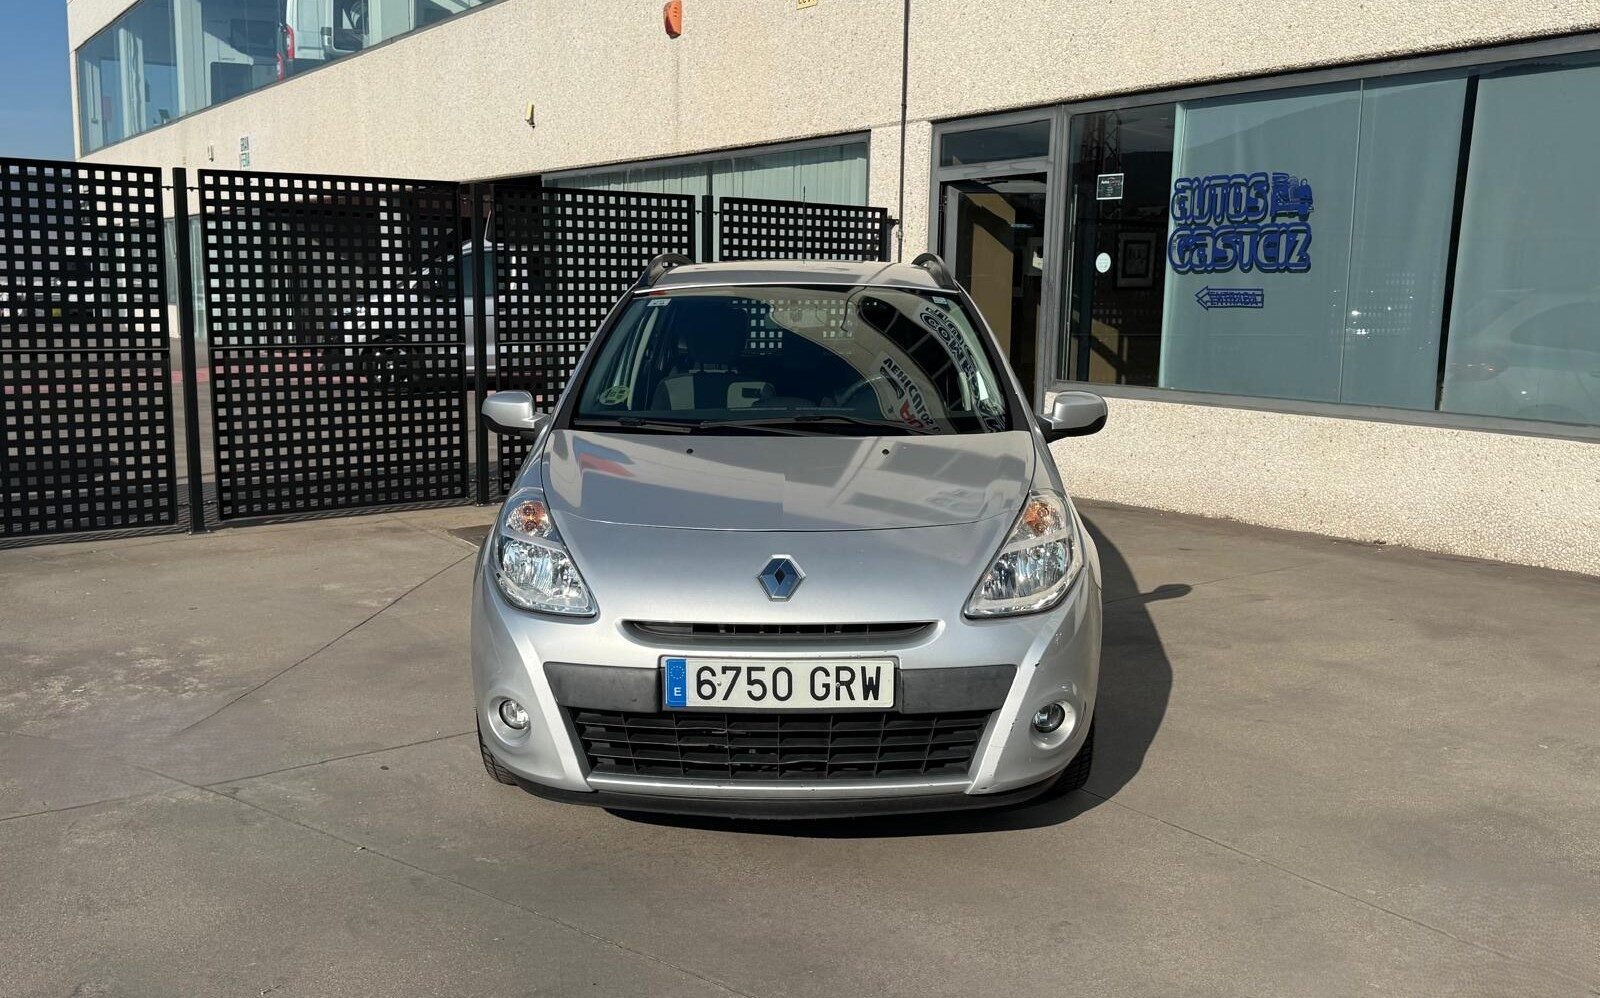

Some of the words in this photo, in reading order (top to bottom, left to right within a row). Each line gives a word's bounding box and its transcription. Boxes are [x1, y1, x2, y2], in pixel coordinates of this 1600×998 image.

[673, 686, 682, 697] E
[696, 665, 793, 702] 6750
[809, 665, 882, 702] GRW
